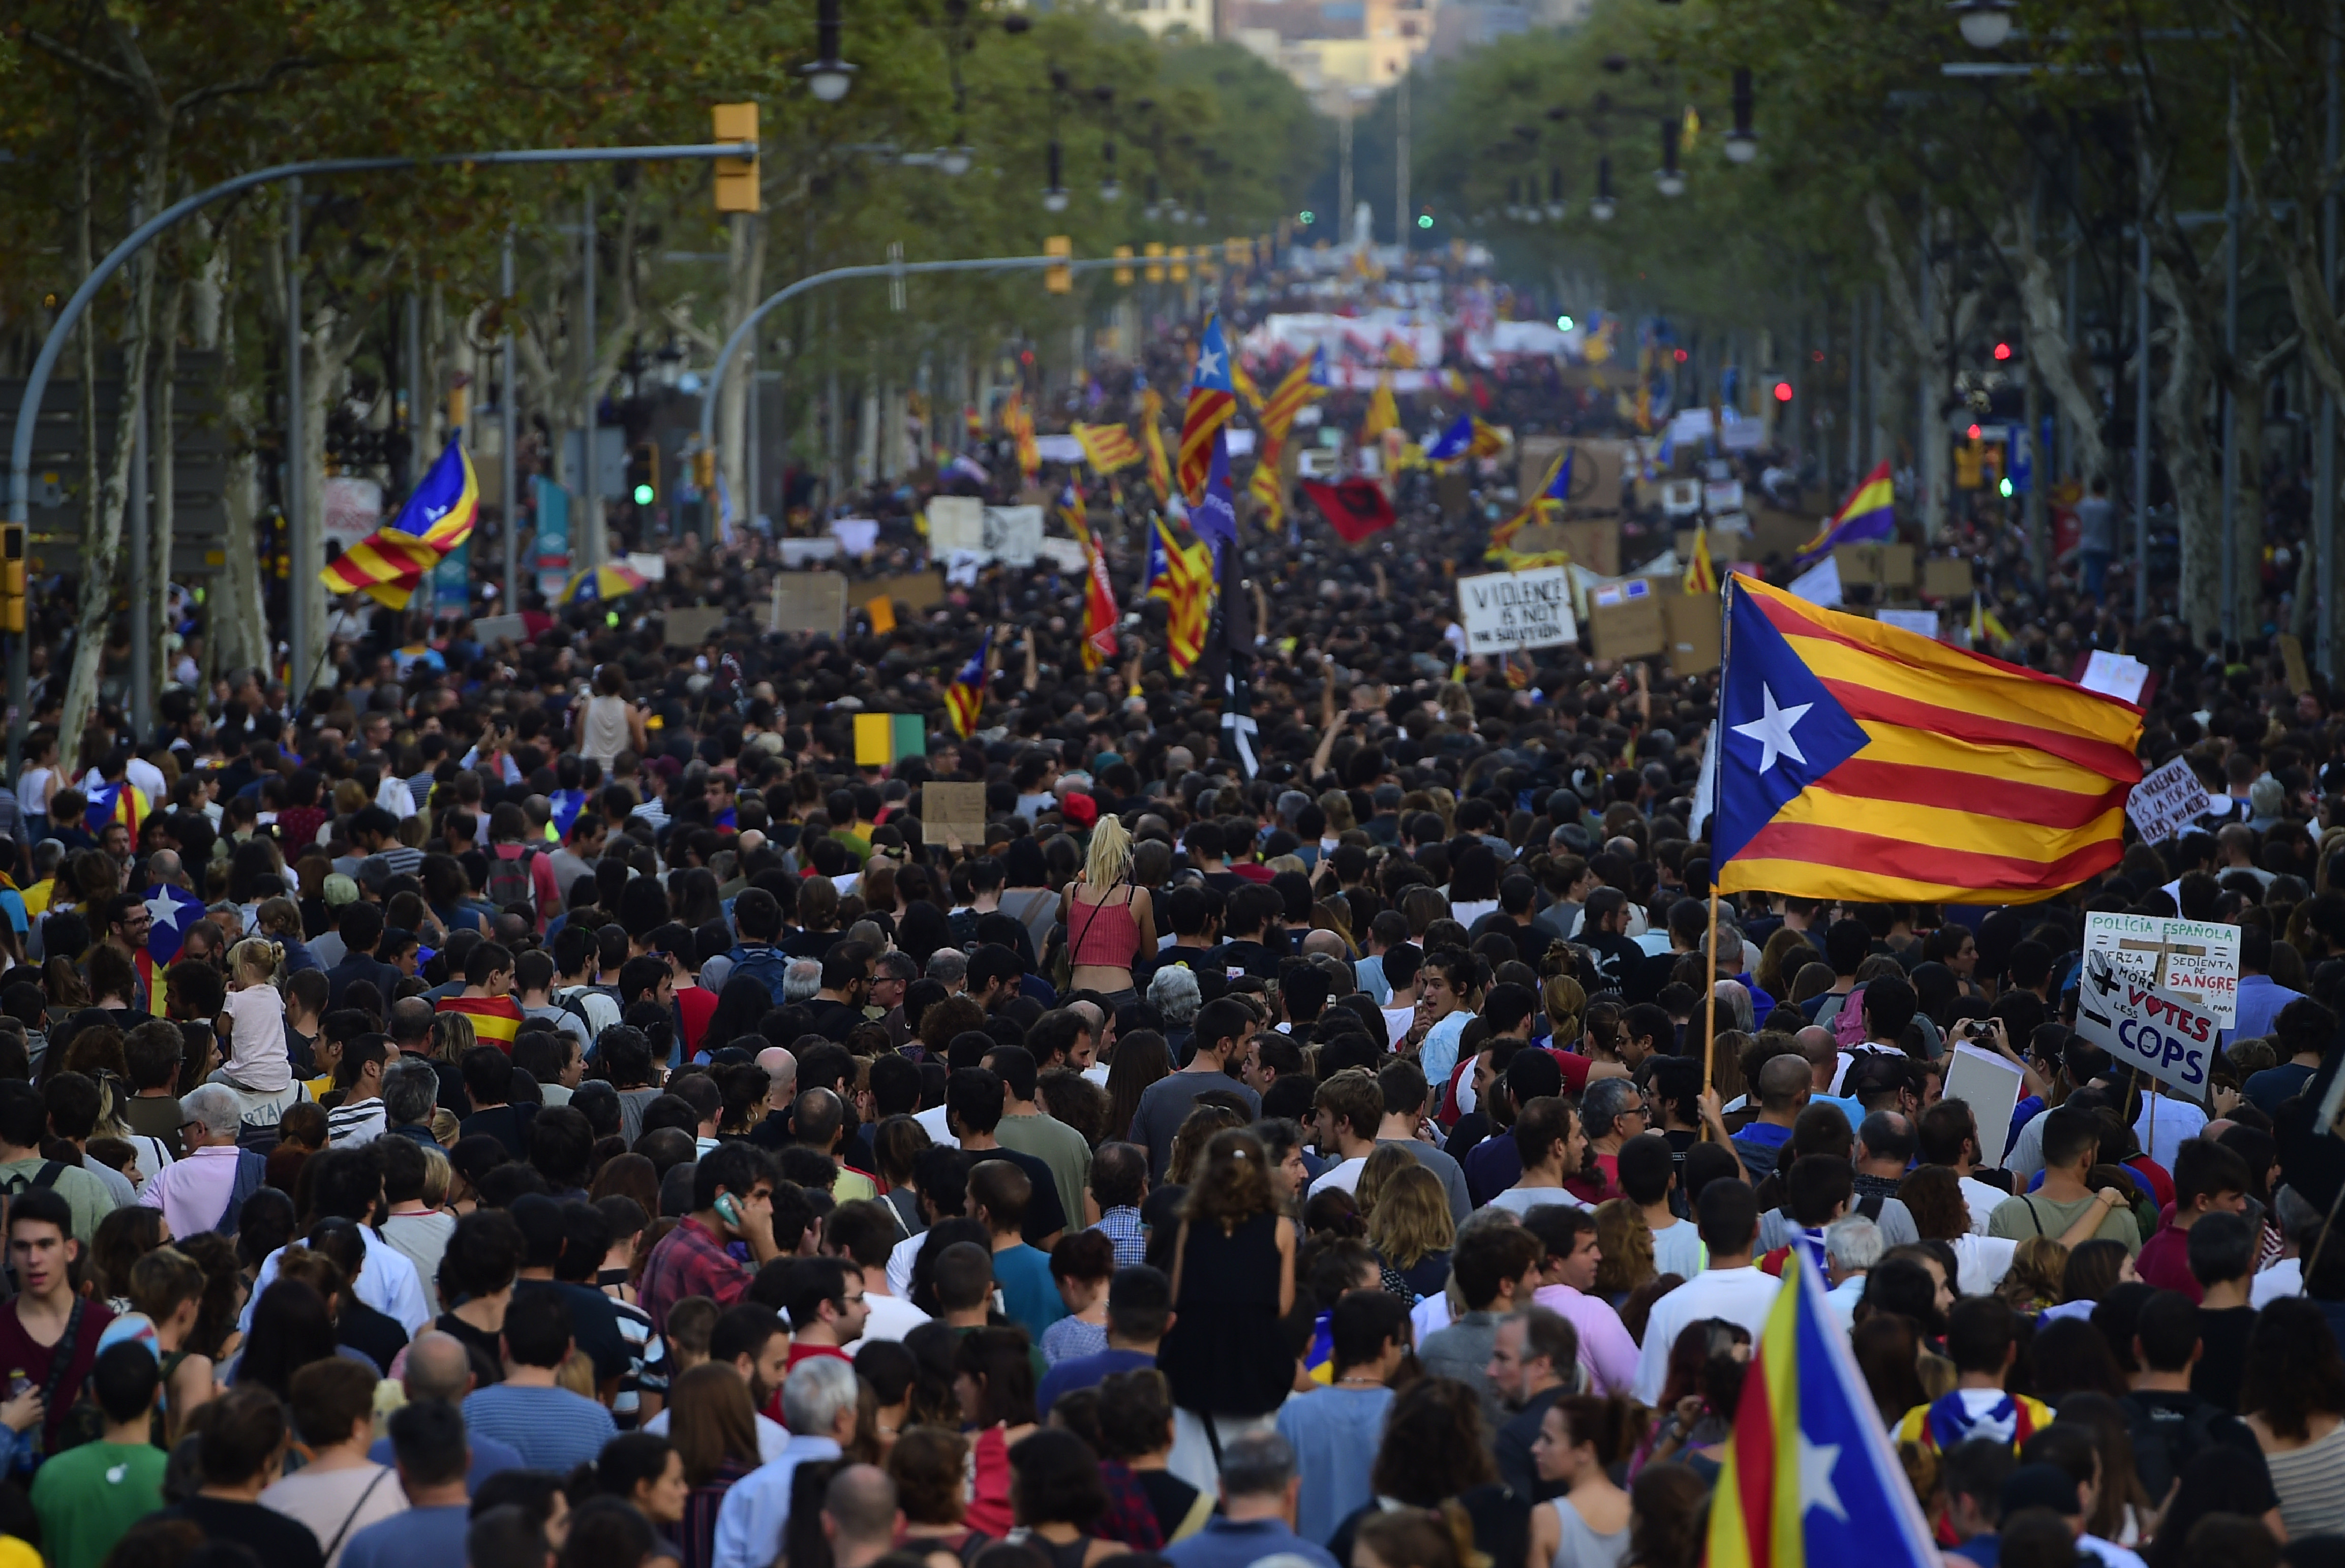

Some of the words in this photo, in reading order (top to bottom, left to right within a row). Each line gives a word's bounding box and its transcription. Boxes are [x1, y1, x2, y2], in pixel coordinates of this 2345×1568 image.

[1471, 577, 1561, 608] VIOLENCE
[1502, 606, 1516, 625] IS
[1520, 601, 1559, 624] NOT
[1496, 624, 1562, 641] SOLUTION
[2163, 922, 2233, 942] ESPAÑOLA
[2172, 956, 2234, 970] SEDIENTA
[2118, 966, 2156, 992] MORE
[2170, 972, 2237, 991] SANGRE
[2113, 1001, 2139, 1019] LESS
[2213, 1004, 2232, 1012] PARA
[2118, 1018, 2204, 1085] COPS
